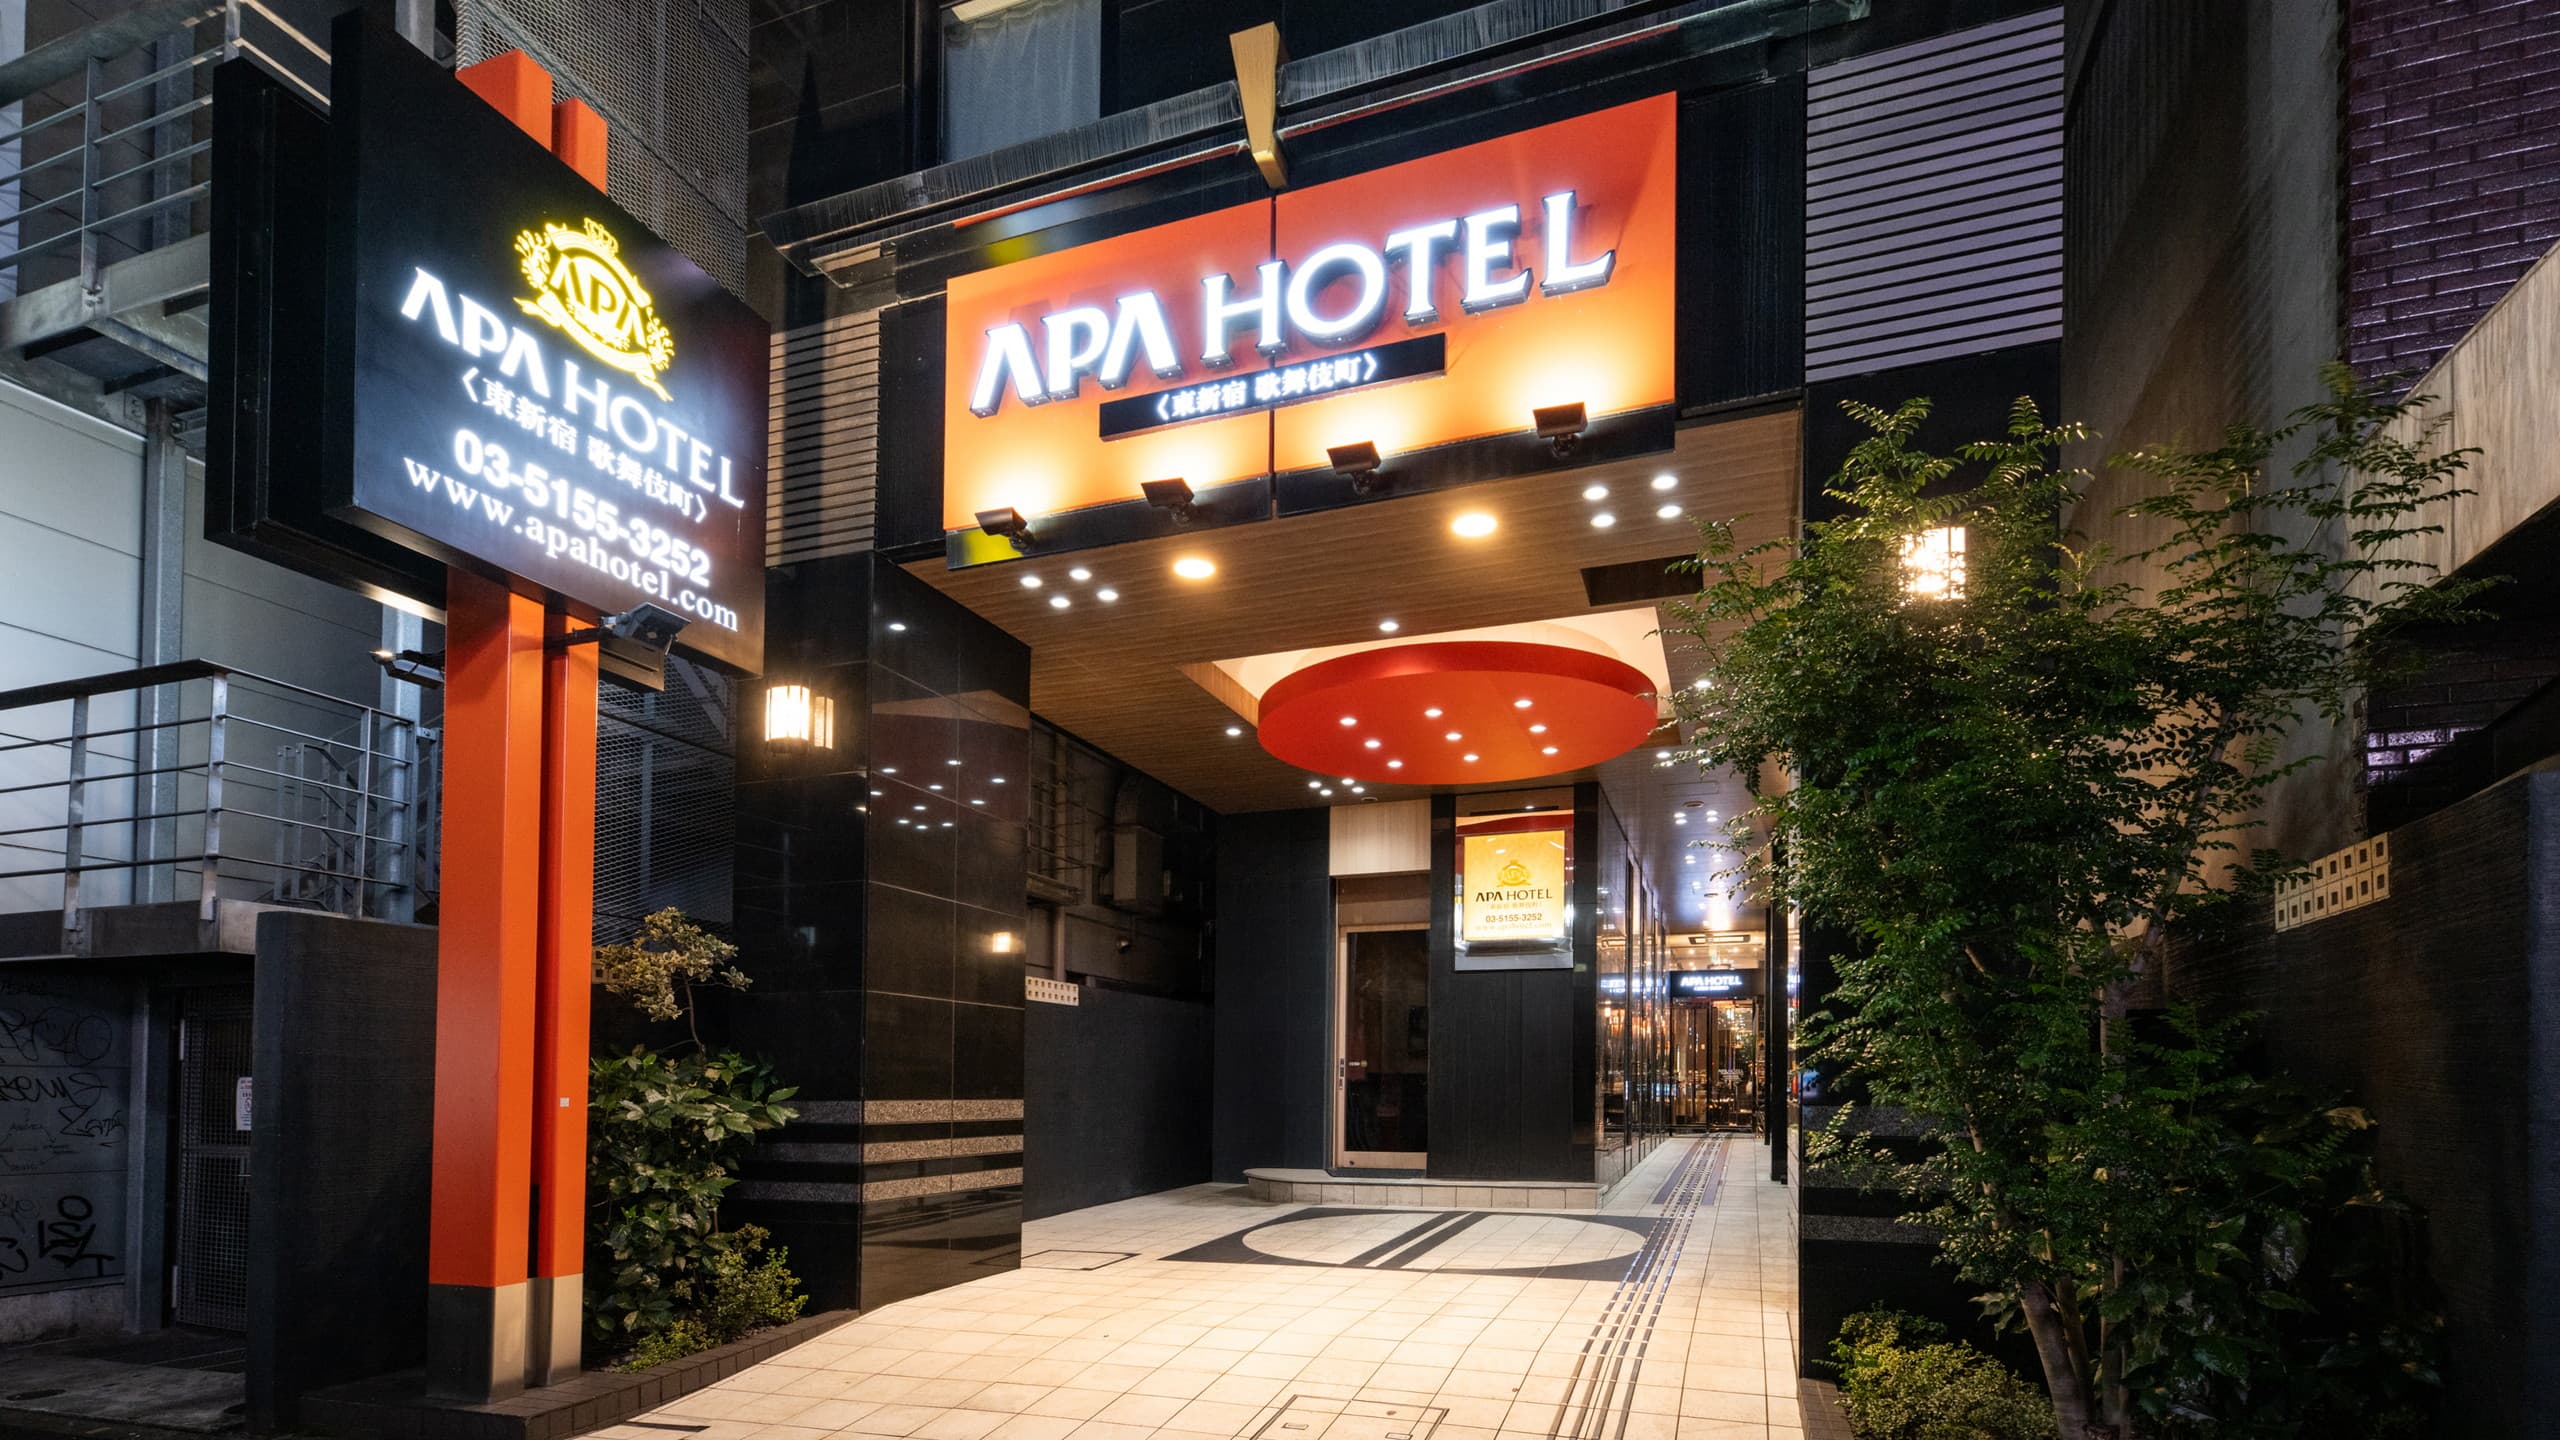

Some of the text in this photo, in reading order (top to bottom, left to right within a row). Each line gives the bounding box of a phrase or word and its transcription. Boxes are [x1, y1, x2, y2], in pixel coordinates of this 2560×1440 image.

[550, 254, 647, 348] APA
[969, 190, 1616, 417] APA HOTEL
[401, 267, 745, 508] APA HOTEL
[403, 457, 739, 632] www.apahotel.com
[454, 429, 711, 587] 03-5155-3252
[1476, 888, 1553, 902] APA HOTEL
[1485, 913, 1543, 923] 03-5155-3252
[1680, 975, 1742, 986] APA HOTEL
